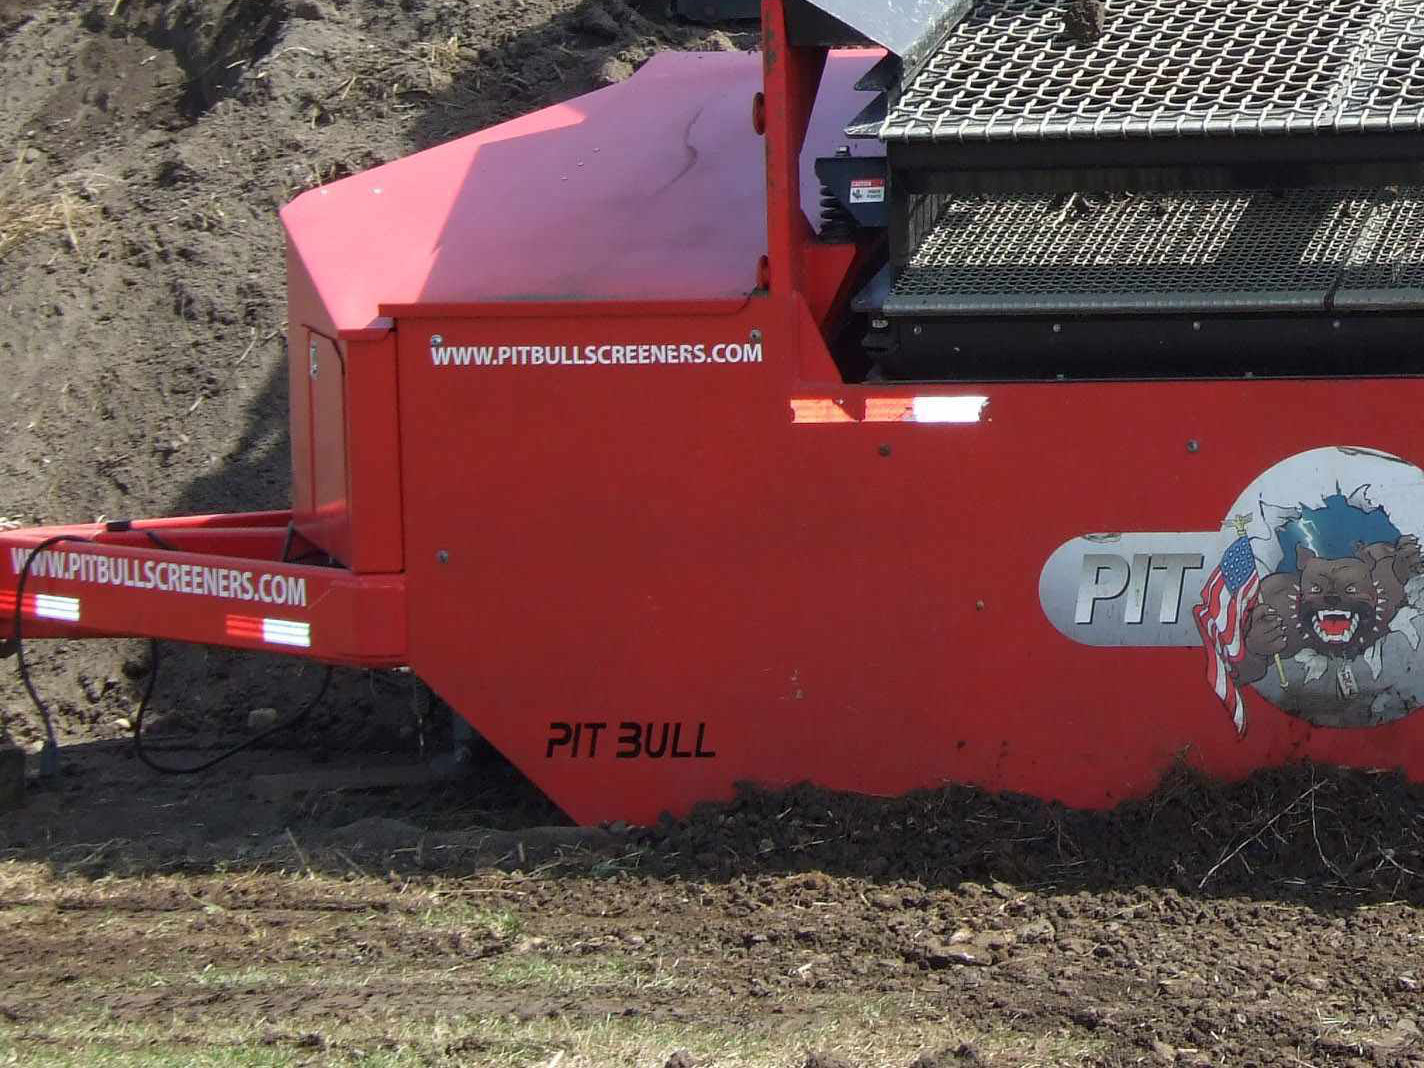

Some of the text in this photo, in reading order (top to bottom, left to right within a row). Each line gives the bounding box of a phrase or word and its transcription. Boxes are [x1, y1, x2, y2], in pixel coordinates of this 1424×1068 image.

[431, 343, 763, 366] WWW.PITBULLSCREENERS.COM
[10, 546, 307, 607] WWW.PITBULLSCREENERS.COM
[1074, 553, 1205, 625] PIT
[545, 721, 717, 759] PIT BULL
